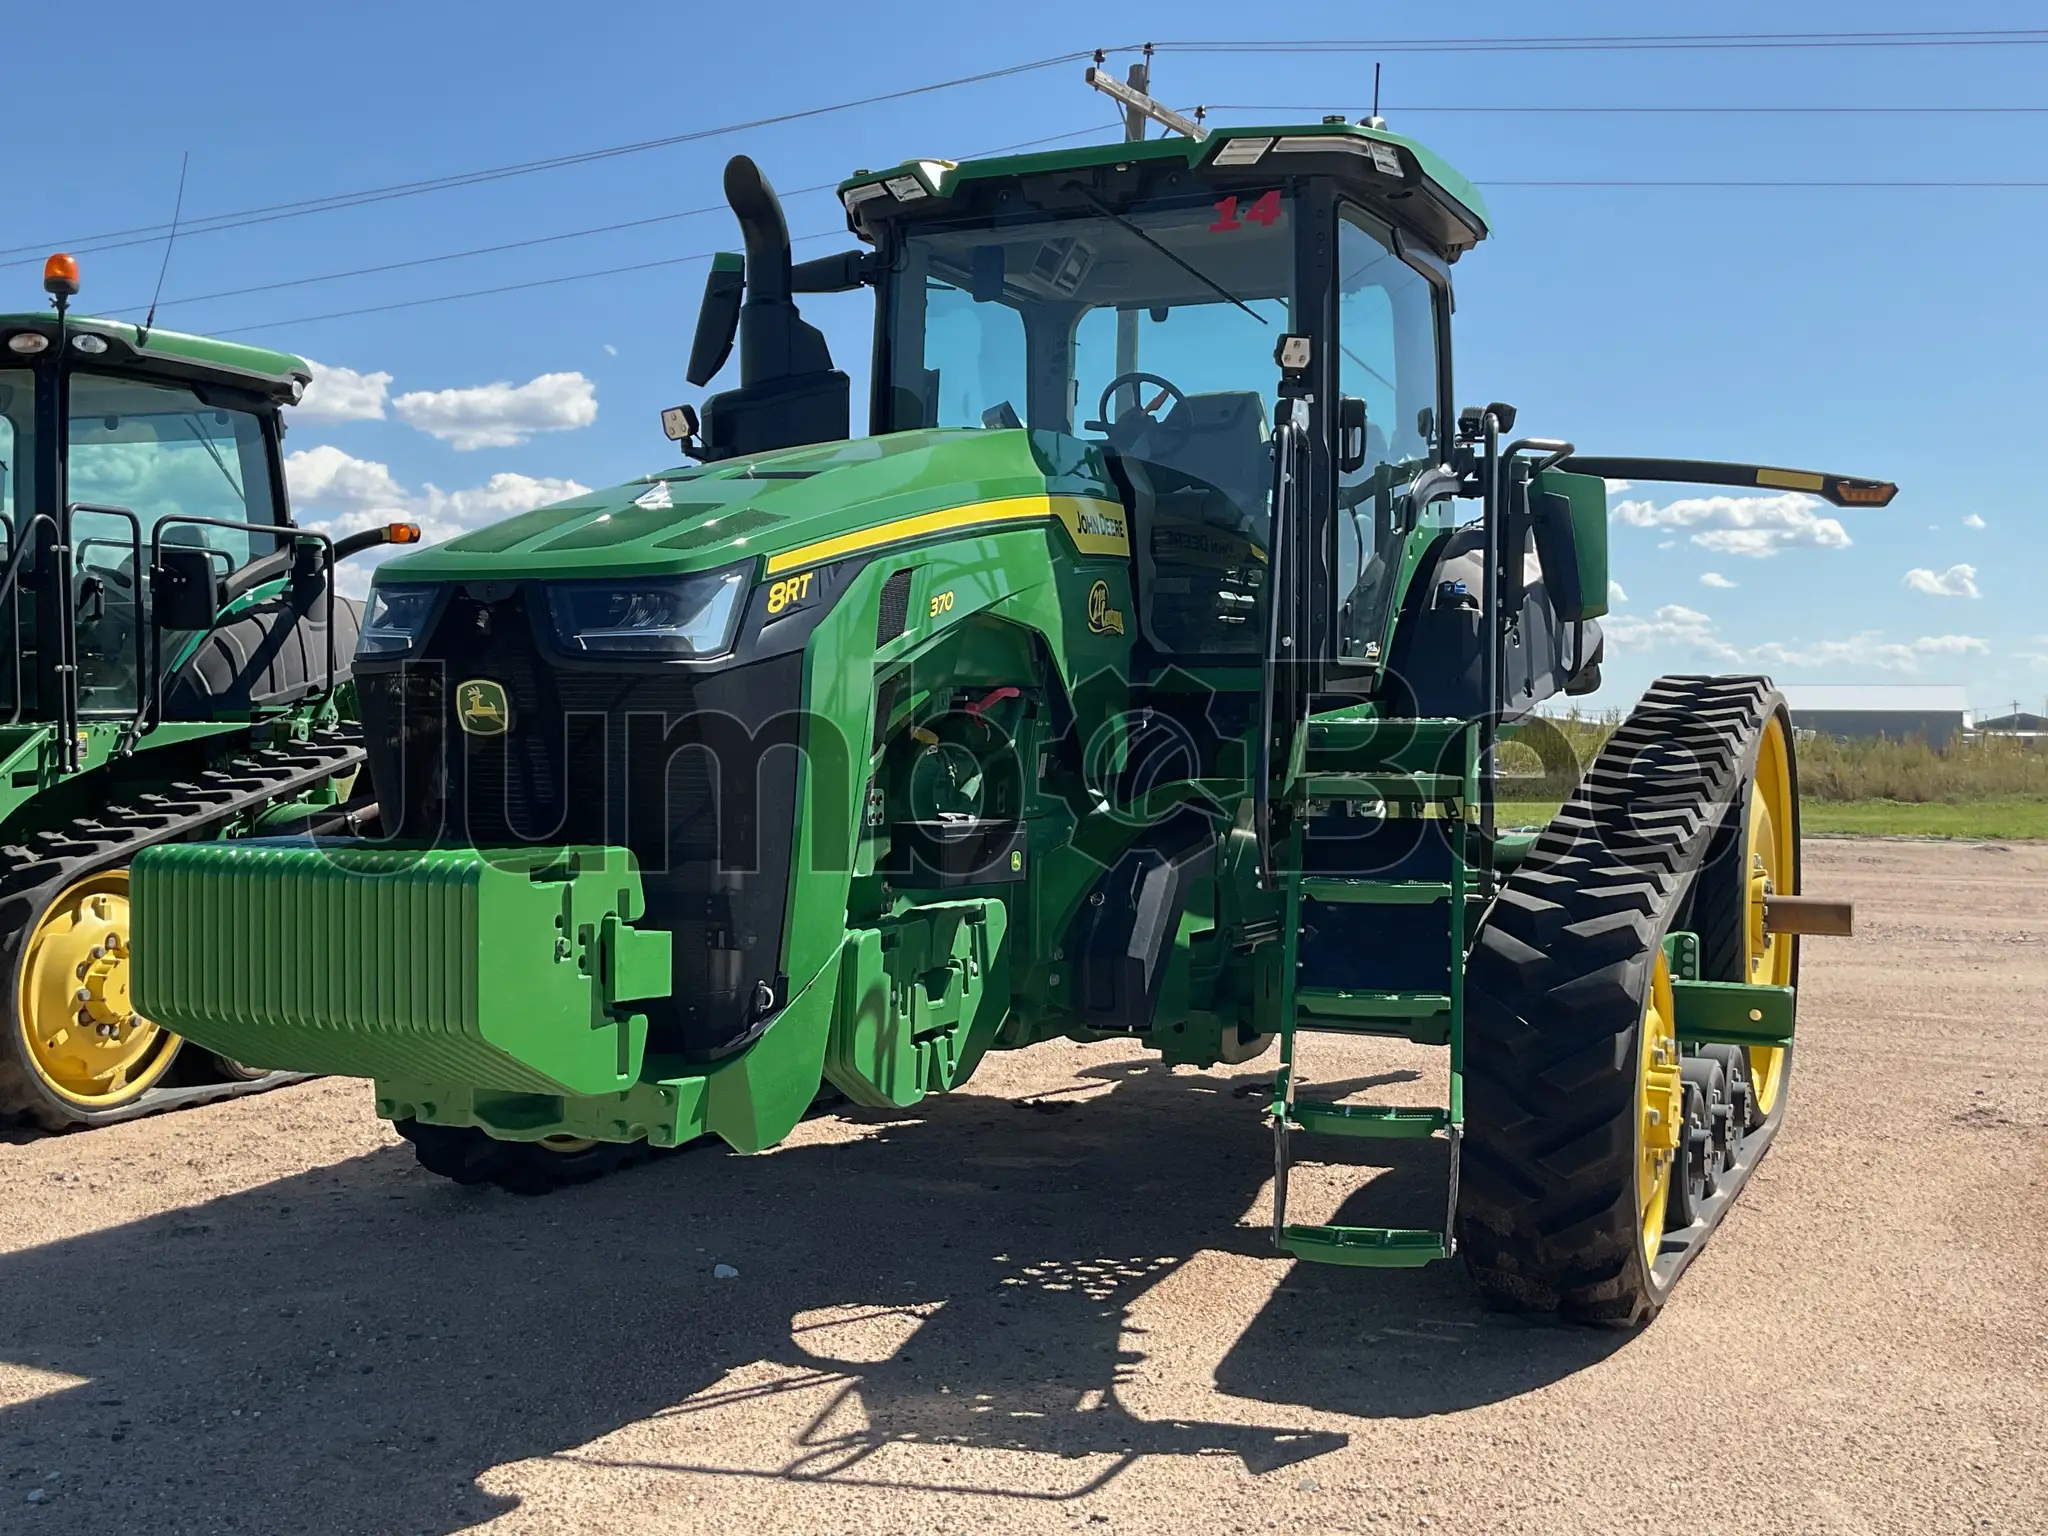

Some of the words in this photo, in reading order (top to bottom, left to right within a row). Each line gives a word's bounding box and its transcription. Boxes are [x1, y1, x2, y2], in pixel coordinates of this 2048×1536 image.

[1208, 190, 1282, 232] 14
[1077, 510, 1100, 535] JOHN
[1099, 513, 1125, 538] DEERE
[767, 572, 813, 614] 8RT
[929, 591, 954, 618] 370
